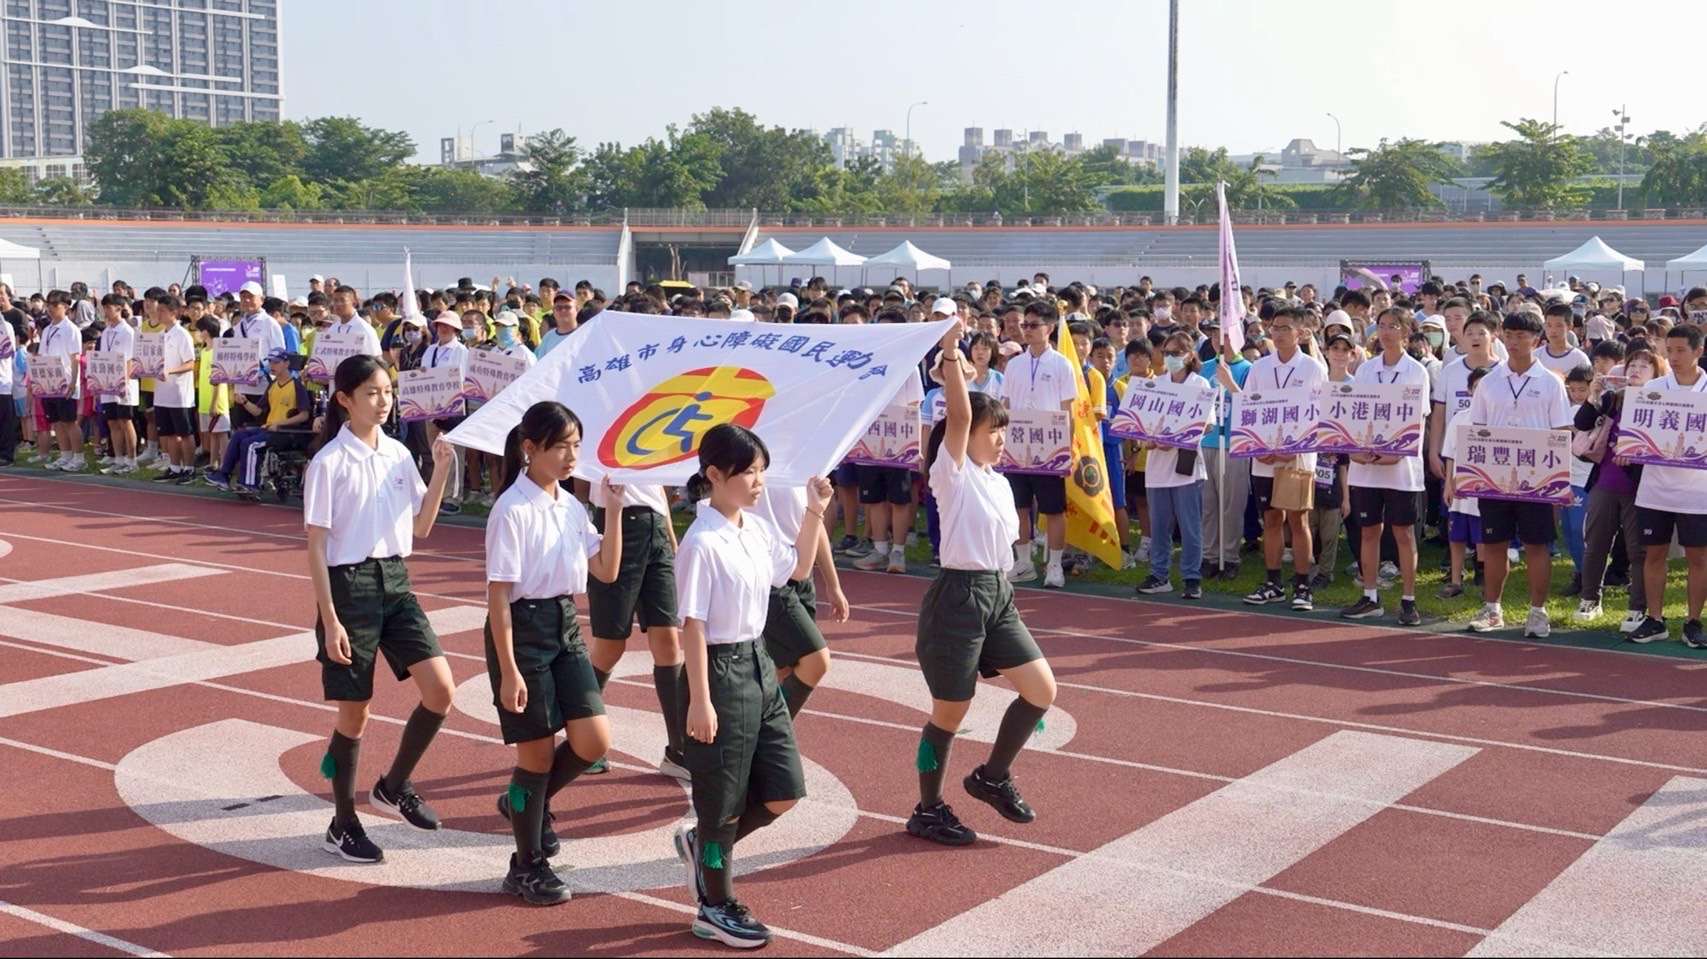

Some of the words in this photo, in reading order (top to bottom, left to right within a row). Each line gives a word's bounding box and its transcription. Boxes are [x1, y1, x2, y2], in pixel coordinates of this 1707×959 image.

[577, 331, 889, 384] 高雄市身心障礙國民運動會
[469, 364, 520, 382] 成功特殊教育學
[1129, 393, 1203, 419] 岡山國小
[1241, 404, 1320, 426] 獅湖國小
[1330, 401, 1413, 422] 小港國中
[1467, 445, 1562, 469] 瑞豐國小
